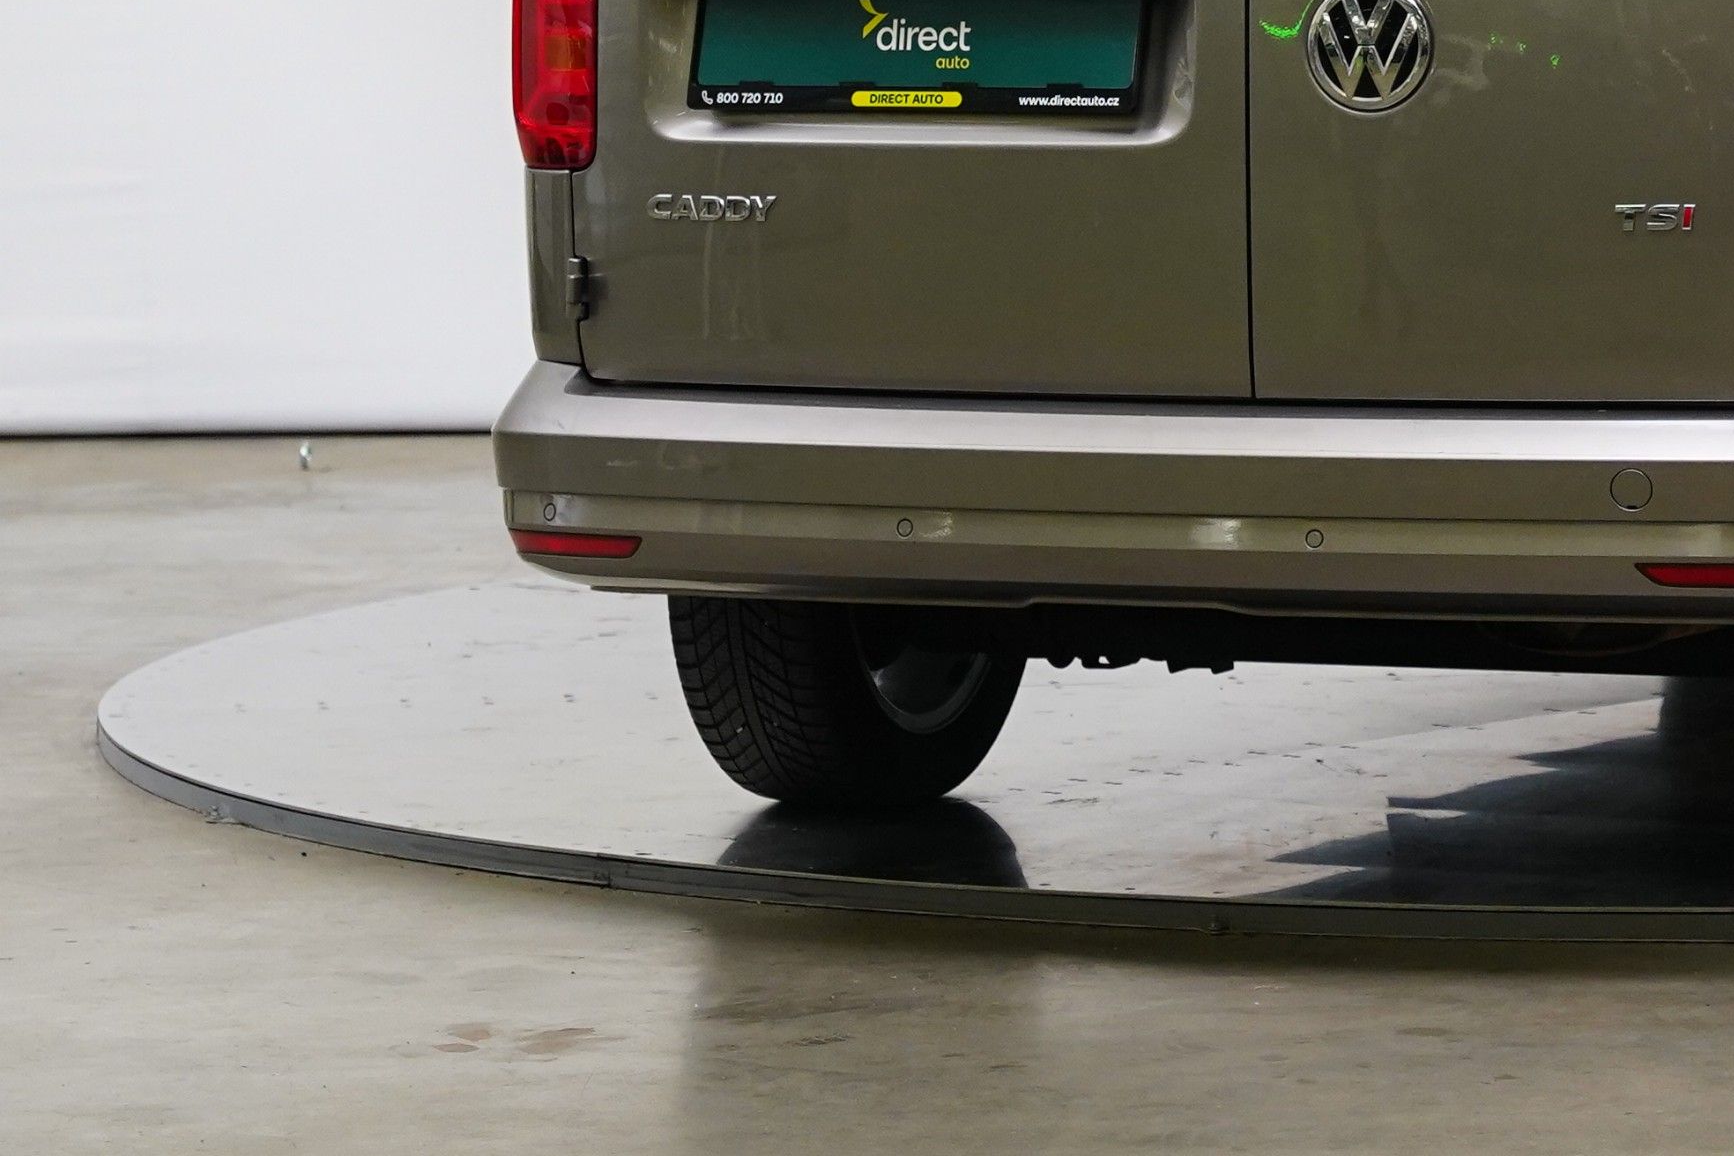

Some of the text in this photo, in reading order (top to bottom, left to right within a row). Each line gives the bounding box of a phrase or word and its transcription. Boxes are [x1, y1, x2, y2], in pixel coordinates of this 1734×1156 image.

[876, 18, 972, 52] direct
[935, 56, 970, 69] auto
[715, 92, 784, 104] 800 720 710
[869, 93, 944, 105] DIRECT AUTO
[1018, 94, 1120, 106] www.directauto.cz
[647, 193, 777, 222] CADDY
[1614, 203, 1697, 231] TSI
